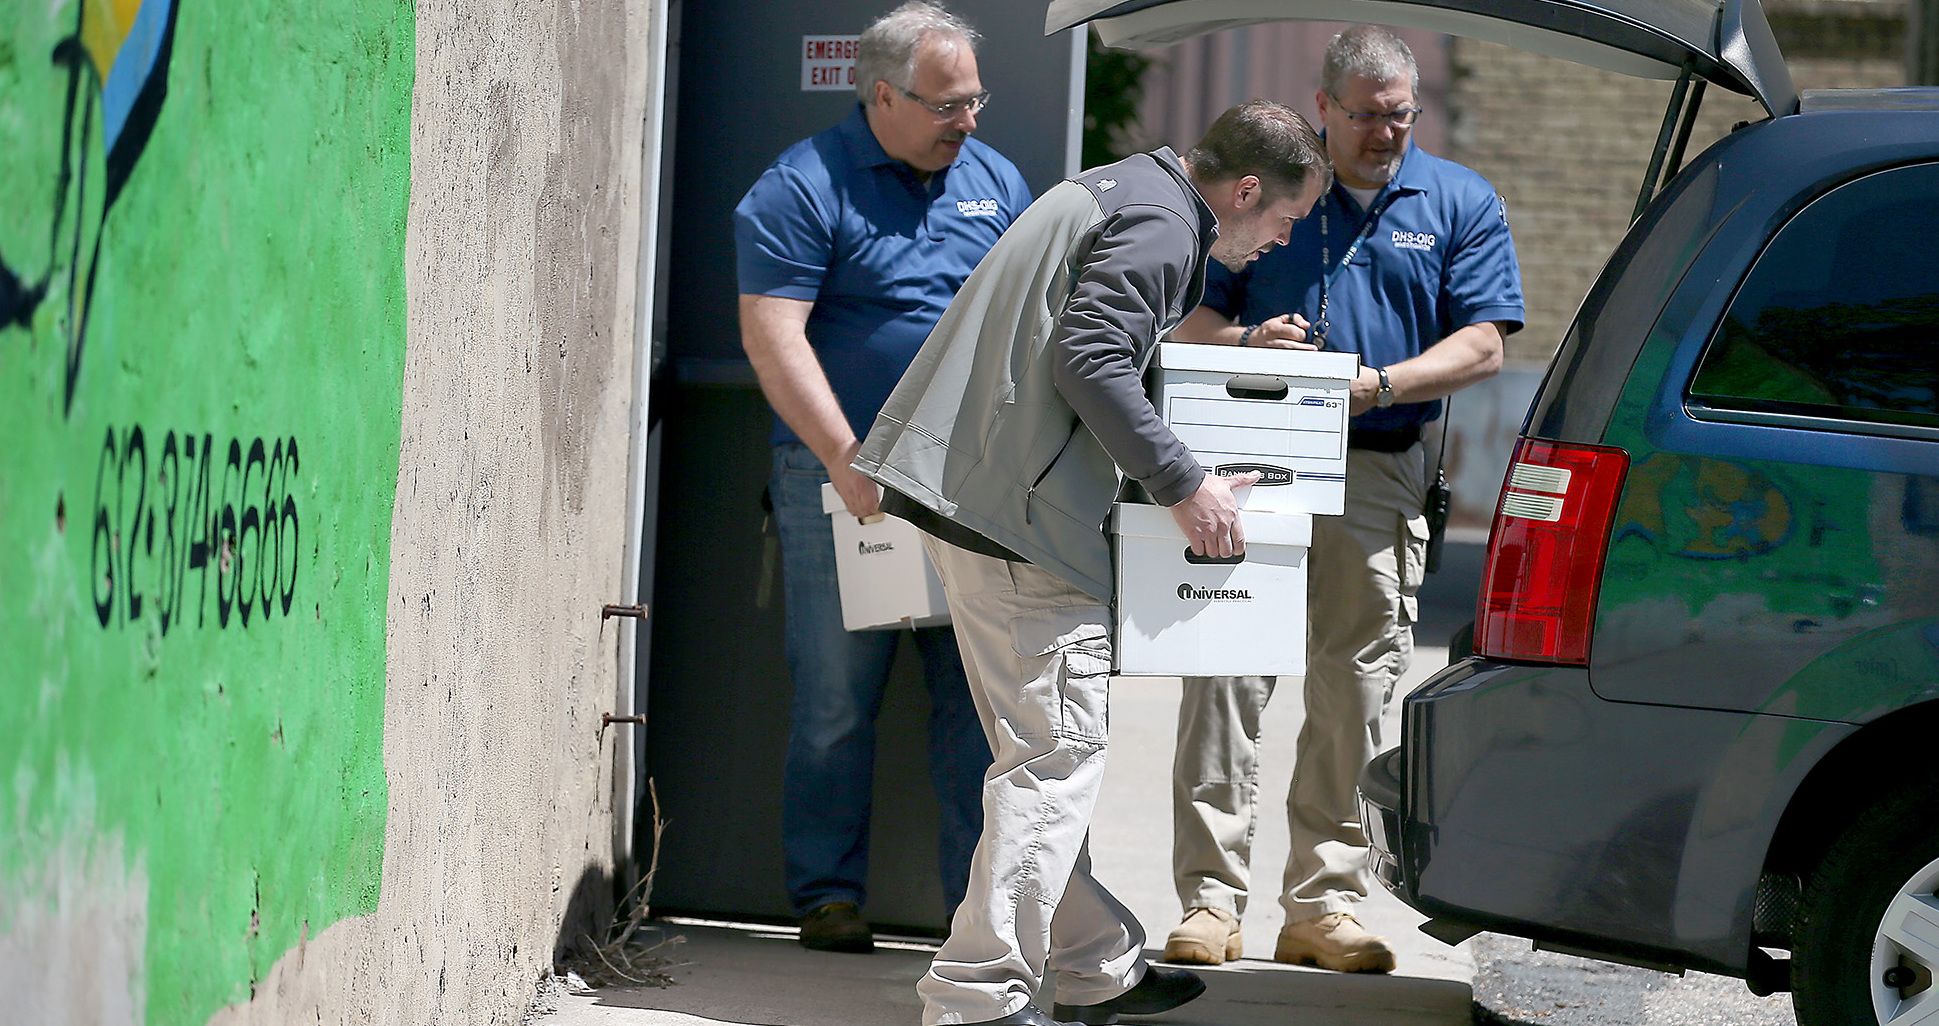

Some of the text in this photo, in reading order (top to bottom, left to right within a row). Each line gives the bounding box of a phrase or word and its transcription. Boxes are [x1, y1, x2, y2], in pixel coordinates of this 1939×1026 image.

[811, 66, 841, 85] EXIT
[956, 199, 998, 212] DHS-OIG
[1391, 231, 1436, 247] DHS-OIG
[1267, 472, 1288, 480] BOX
